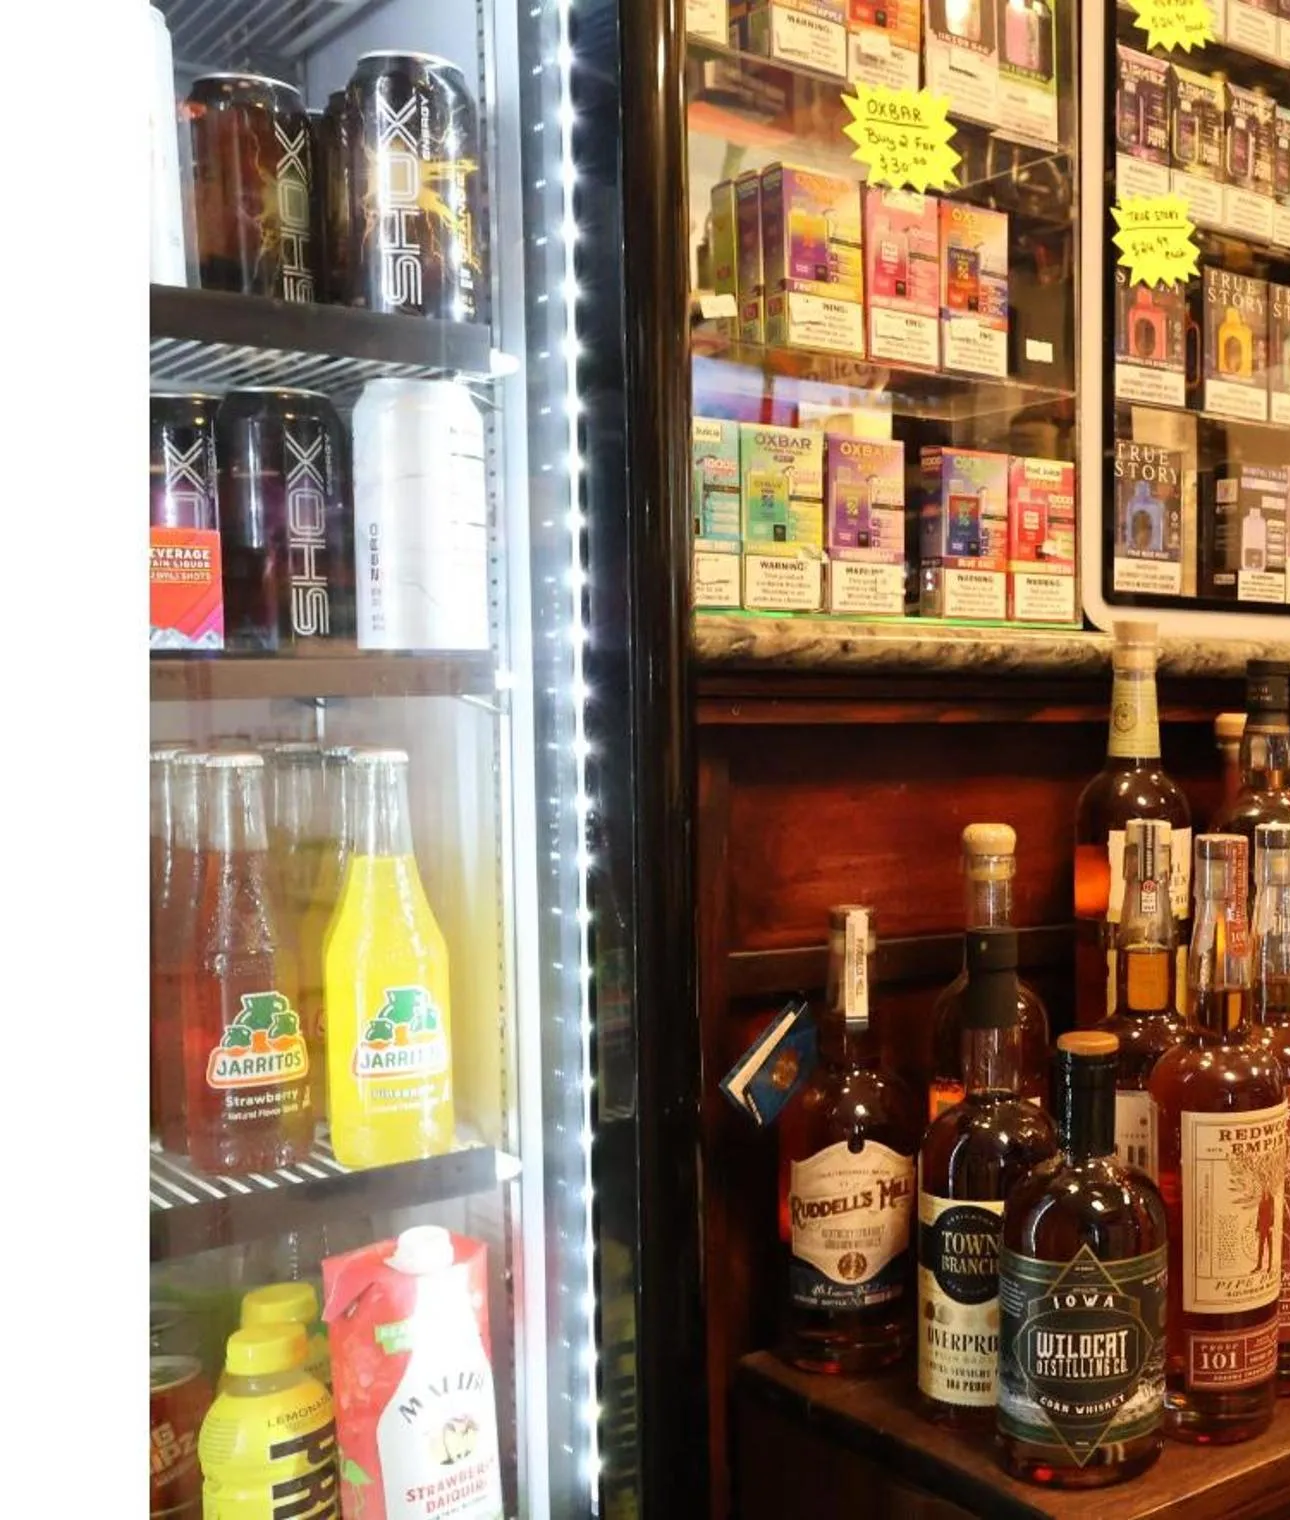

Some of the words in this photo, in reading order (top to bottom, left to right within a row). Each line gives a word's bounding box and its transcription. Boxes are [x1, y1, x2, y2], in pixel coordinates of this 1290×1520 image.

[866, 98, 922, 122] OXBAR
[420, 94, 431, 160] ENERGY
[864, 127, 897, 152] Buy
[899, 134, 909, 148] 2
[375, 94, 423, 306] SHOX
[1209, 269, 1256, 294] TRUE
[1207, 287, 1264, 314] STORY
[754, 431, 813, 449] OXBAR
[1115, 442, 1169, 465] TRUE
[1114, 461, 1178, 485] STORY
[284, 430, 330, 636] SHOX
[216, 1050, 302, 1077] JARRITOS
[359, 1047, 442, 1070] JARRIT
[225, 1088, 299, 1107] Strawberry
[941, 1230, 1001, 1255] TOWN
[1053, 1294, 1115, 1310] IOWA
[1036, 1330, 1129, 1359] WILDCAT
[1036, 1357, 1110, 1378] DISTILLING
[1201, 1350, 1238, 1370] 101
[1041, 1396, 1070, 1415] CORN
[404, 1458, 493, 1503] STRAWBER
